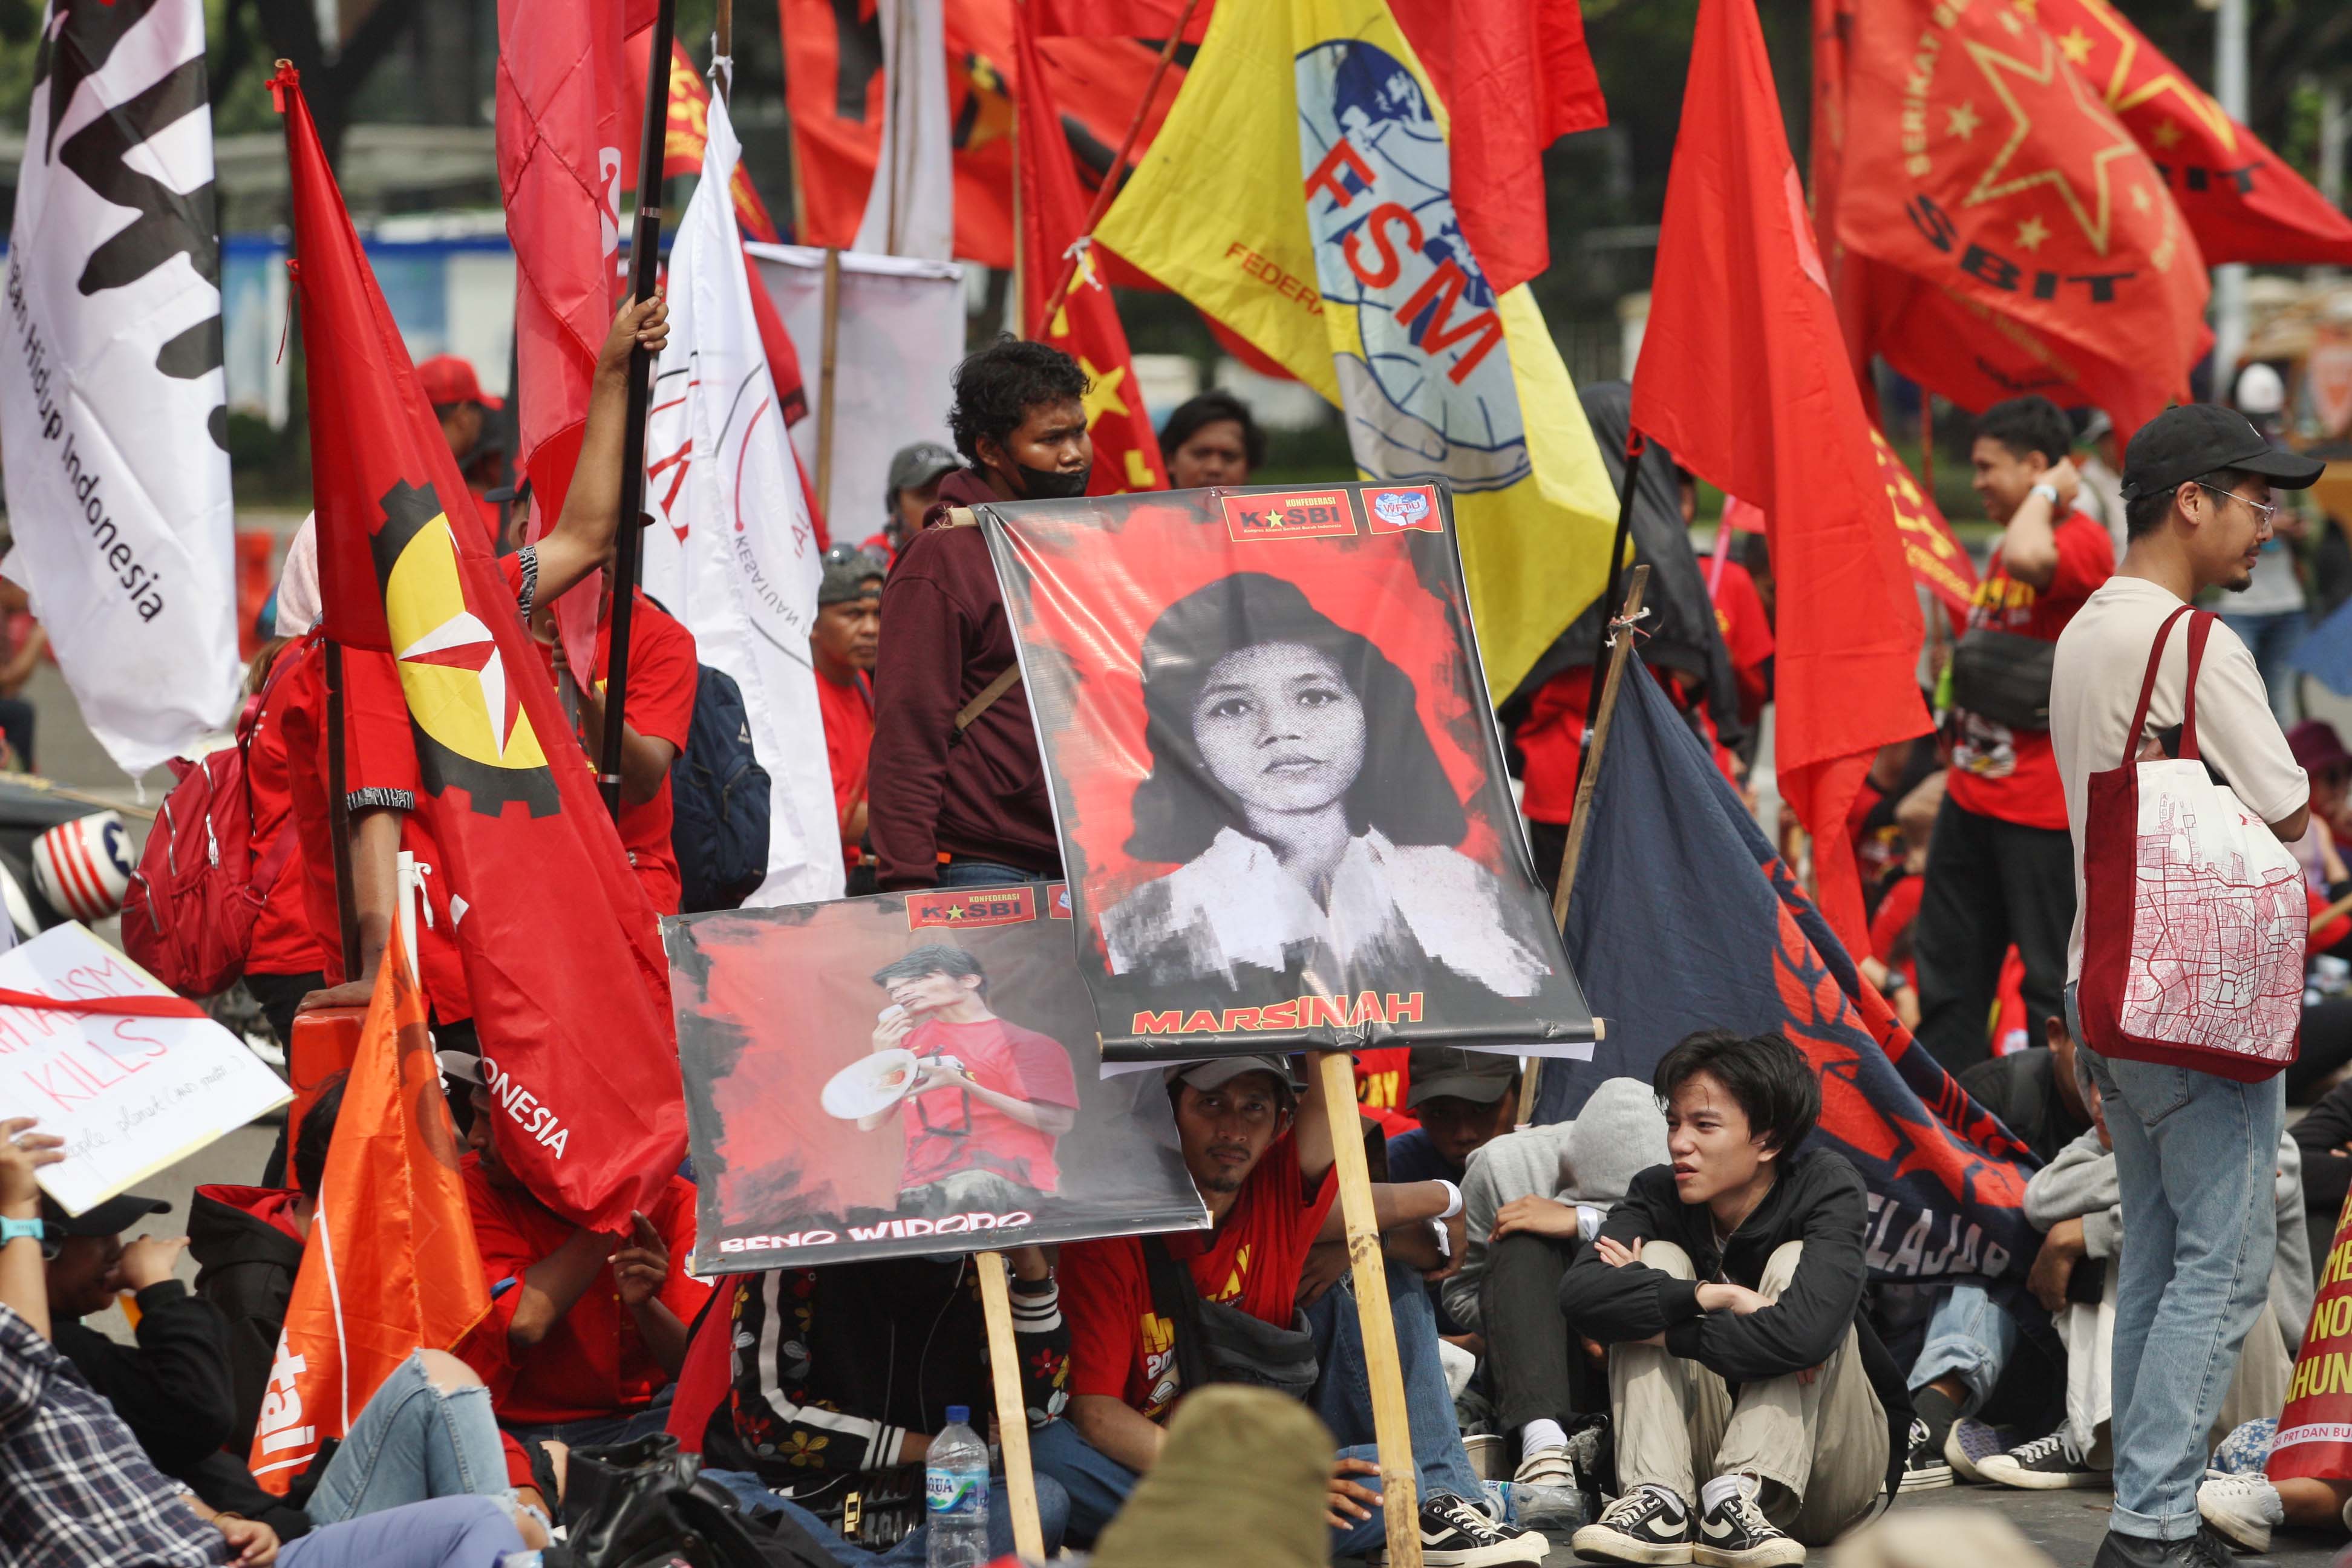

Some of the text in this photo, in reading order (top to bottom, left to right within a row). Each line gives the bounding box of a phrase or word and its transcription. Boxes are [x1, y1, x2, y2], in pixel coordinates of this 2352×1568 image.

[1305, 137, 1504, 386] FSM
[1906, 194, 2136, 303] SBIT
[23, 322, 63, 440] Hidup
[62, 433, 163, 624] Indonesia
[1240, 506, 1341, 528] KASBI
[1285, 496, 1336, 508] KONFEDERASI
[1383, 501, 1421, 513] WFTU
[921, 901, 1022, 920] KASBI
[969, 893, 1020, 903] KONFEDERASI
[1132, 990, 1424, 1035] MARSINAH
[23, 1018, 168, 1112] KILLS
[720, 1211, 1032, 1253] BENO WIDODO
[2284, 1430, 2299, 1443] PRT
[2302, 1427, 2328, 1438] DAN
[2333, 1427, 2352, 1437] BU
